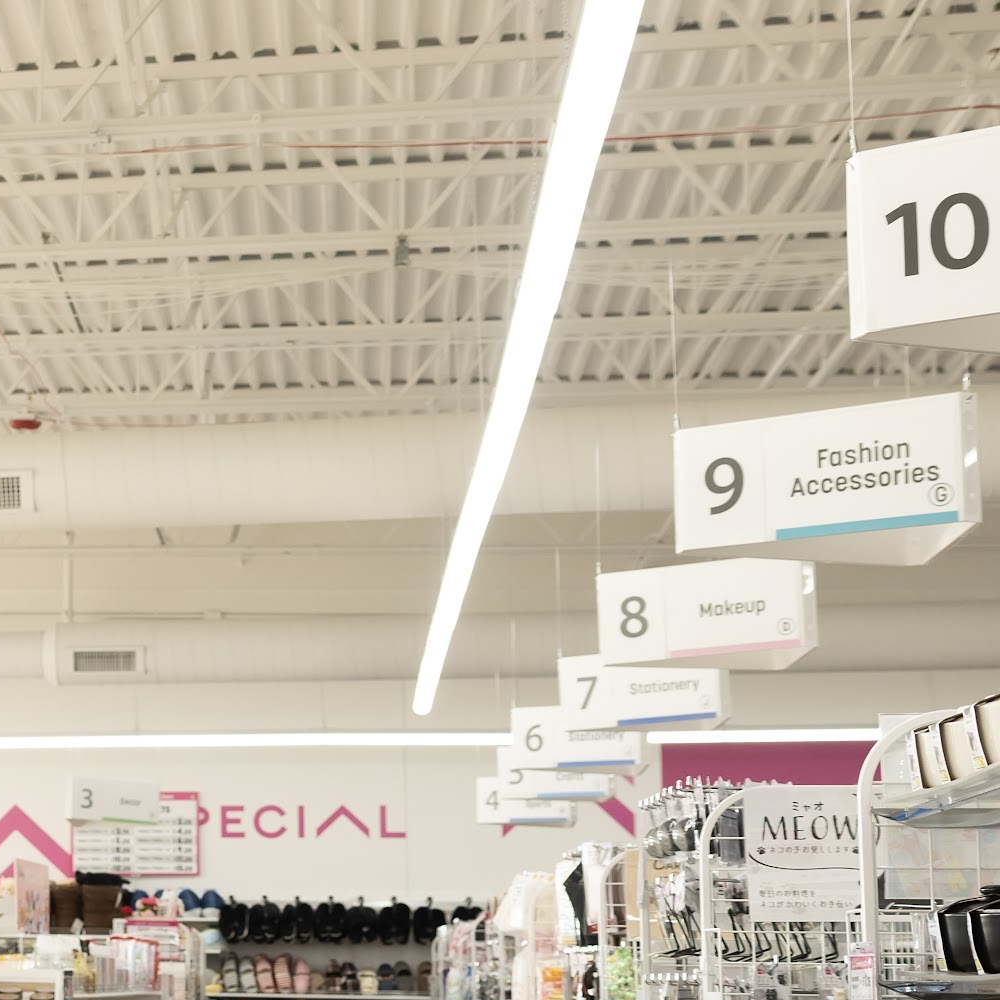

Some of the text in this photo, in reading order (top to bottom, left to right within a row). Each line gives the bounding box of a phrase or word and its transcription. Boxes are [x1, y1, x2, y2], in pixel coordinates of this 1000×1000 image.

[885, 192, 990, 277] 10
[817, 440, 910, 469] Fashion
[704, 457, 744, 515] 9
[790, 463, 940, 498] Accessories
[620, 596, 649, 638] 8
[699, 599, 766, 618] Makeup
[576, 676, 598, 709] 7
[629, 679, 700, 695] Stationery
[525, 725, 543, 751] 6
[80, 788, 93, 808] 3
[485, 790, 499, 810] 4
[792, 801, 824, 811] ミャオ
[762, 815, 858, 841] MEOW
